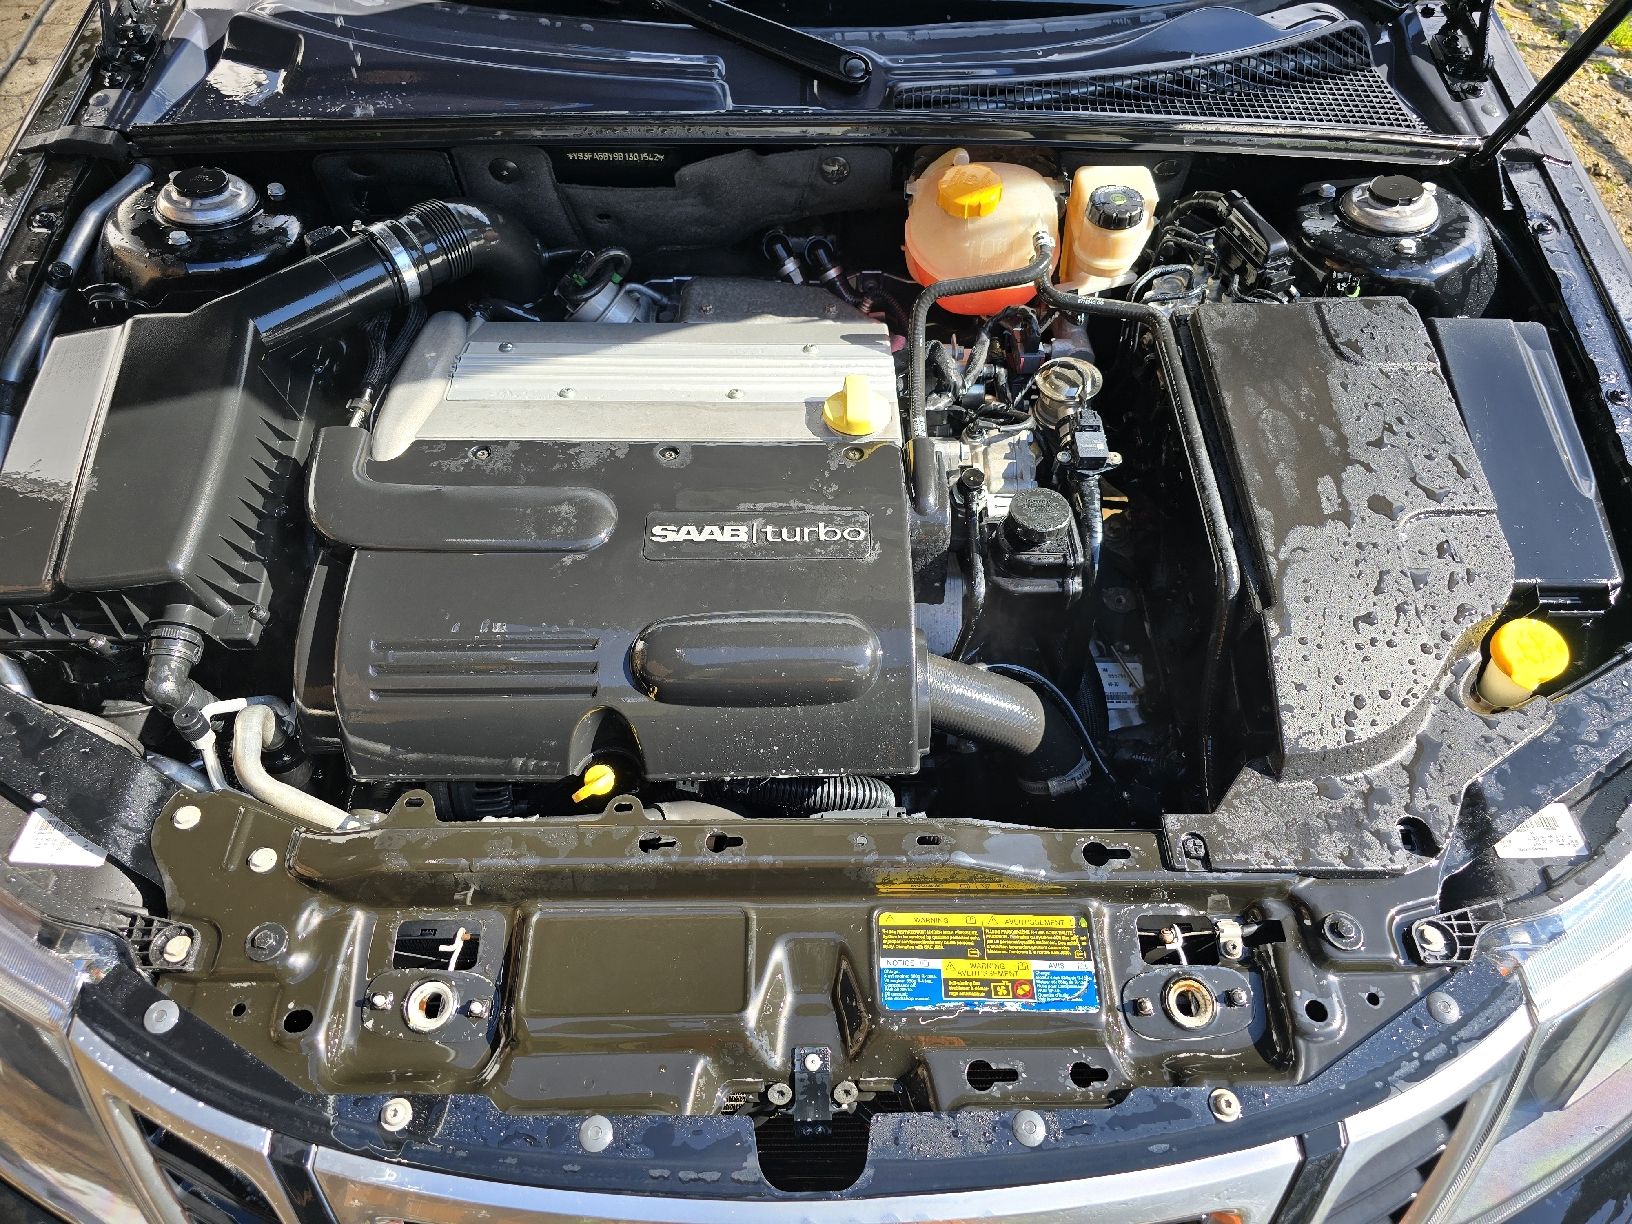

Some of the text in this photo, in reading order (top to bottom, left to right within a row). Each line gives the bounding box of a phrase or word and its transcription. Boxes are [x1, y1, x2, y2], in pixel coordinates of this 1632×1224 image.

[649, 521, 866, 543] SAAB turbo
[886, 959, 915, 967] NOTICE
[970, 962, 1006, 970] WARNING
[1048, 962, 1065, 970] AVIS
